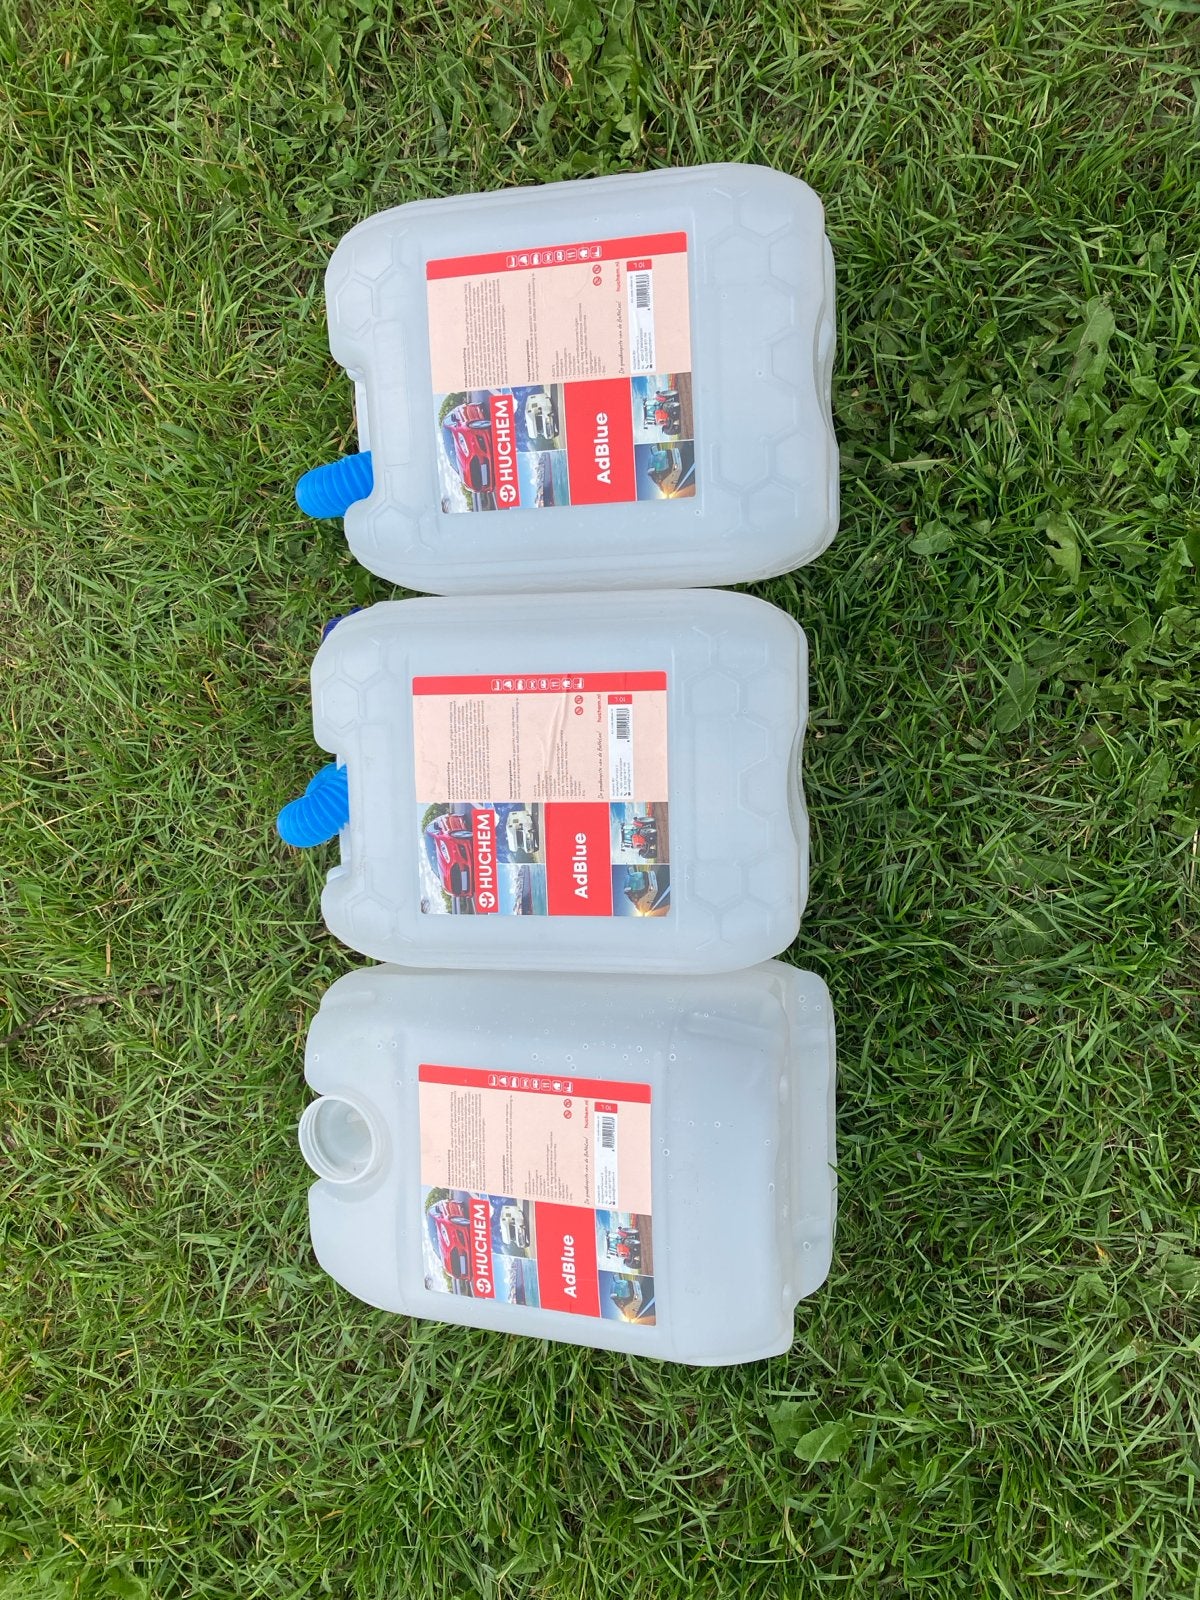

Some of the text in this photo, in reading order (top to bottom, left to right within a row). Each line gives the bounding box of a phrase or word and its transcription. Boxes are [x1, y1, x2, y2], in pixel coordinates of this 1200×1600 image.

[494, 399, 513, 481] HUCHEM
[593, 412, 612, 485] AdBlue
[476, 813, 493, 889] HUCHEM
[572, 832, 589, 899] AdBlue
[473, 1204, 489, 1276] HUCHEM
[561, 1234, 578, 1299] AdBlue
